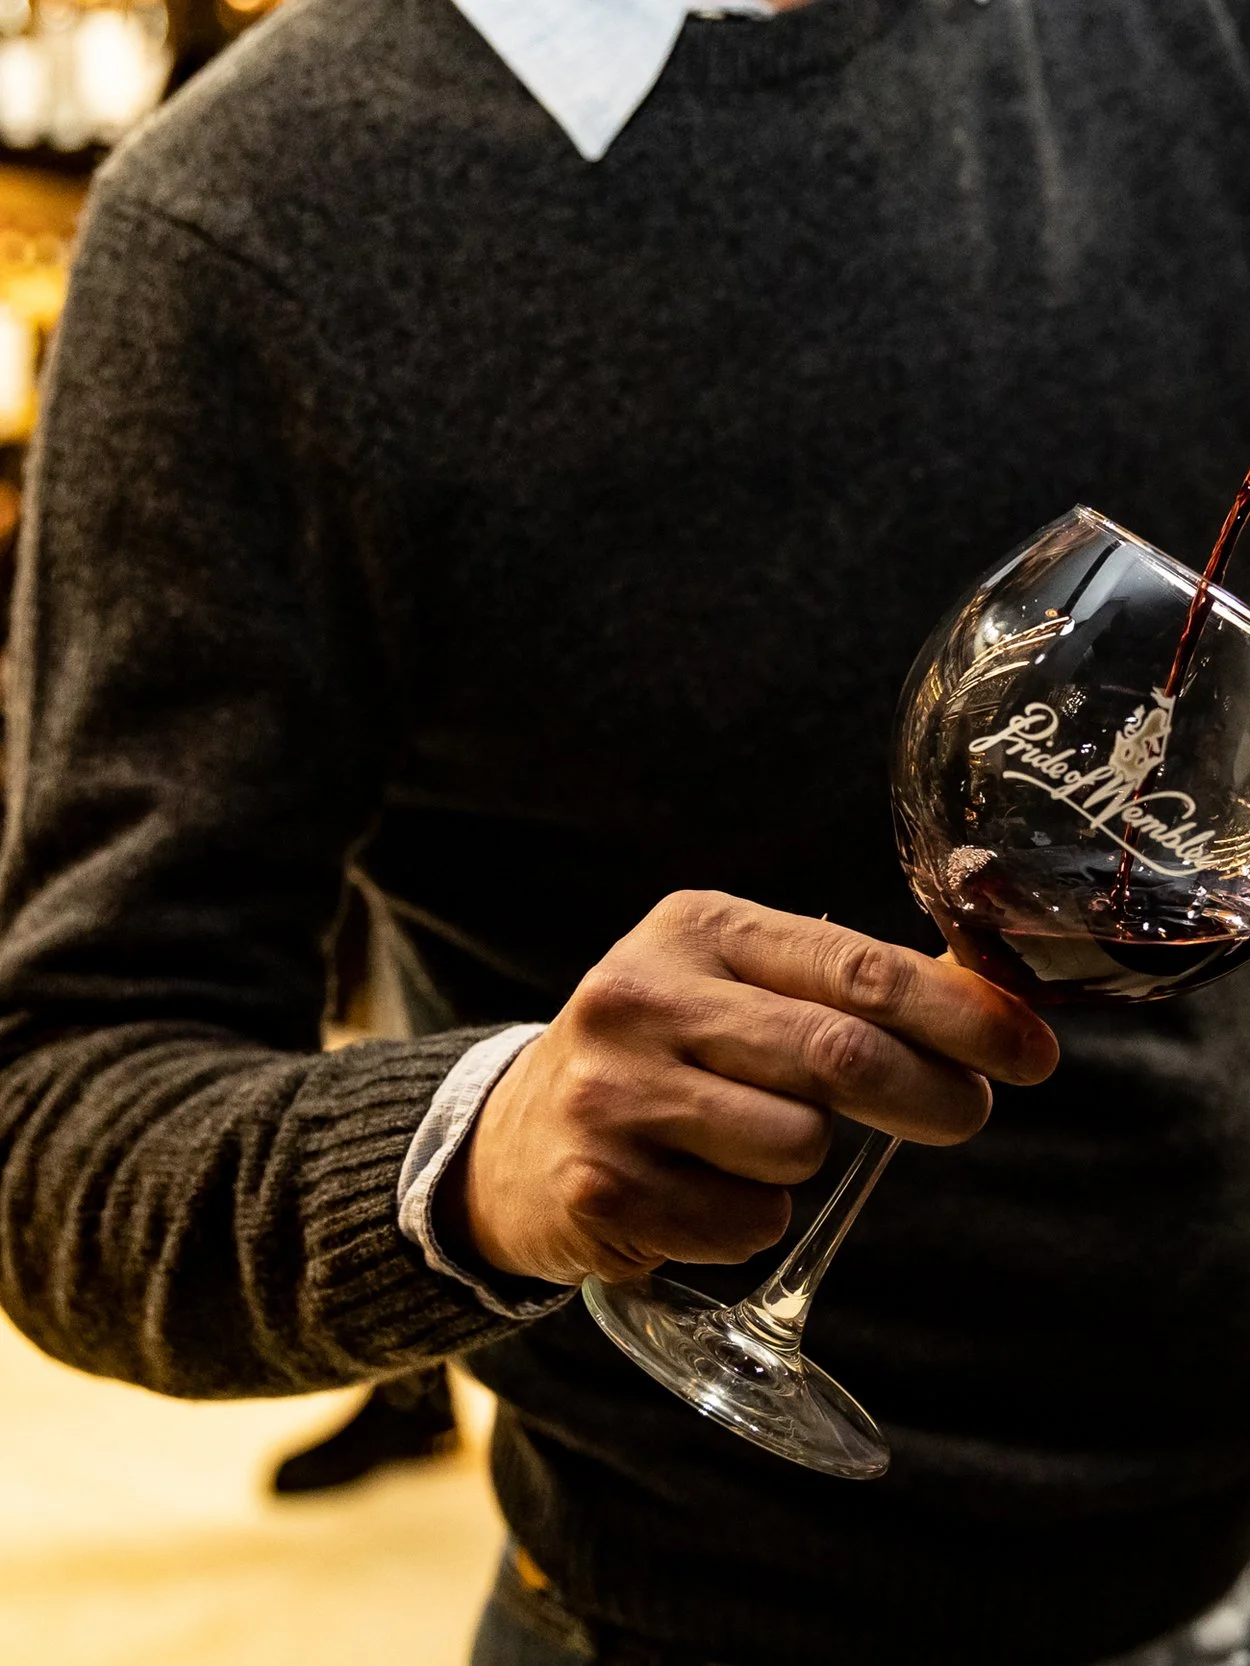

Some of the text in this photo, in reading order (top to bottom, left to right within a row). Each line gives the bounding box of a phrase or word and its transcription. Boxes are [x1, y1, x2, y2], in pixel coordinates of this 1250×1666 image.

[969, 702, 1216, 871] Pride of Wembley
